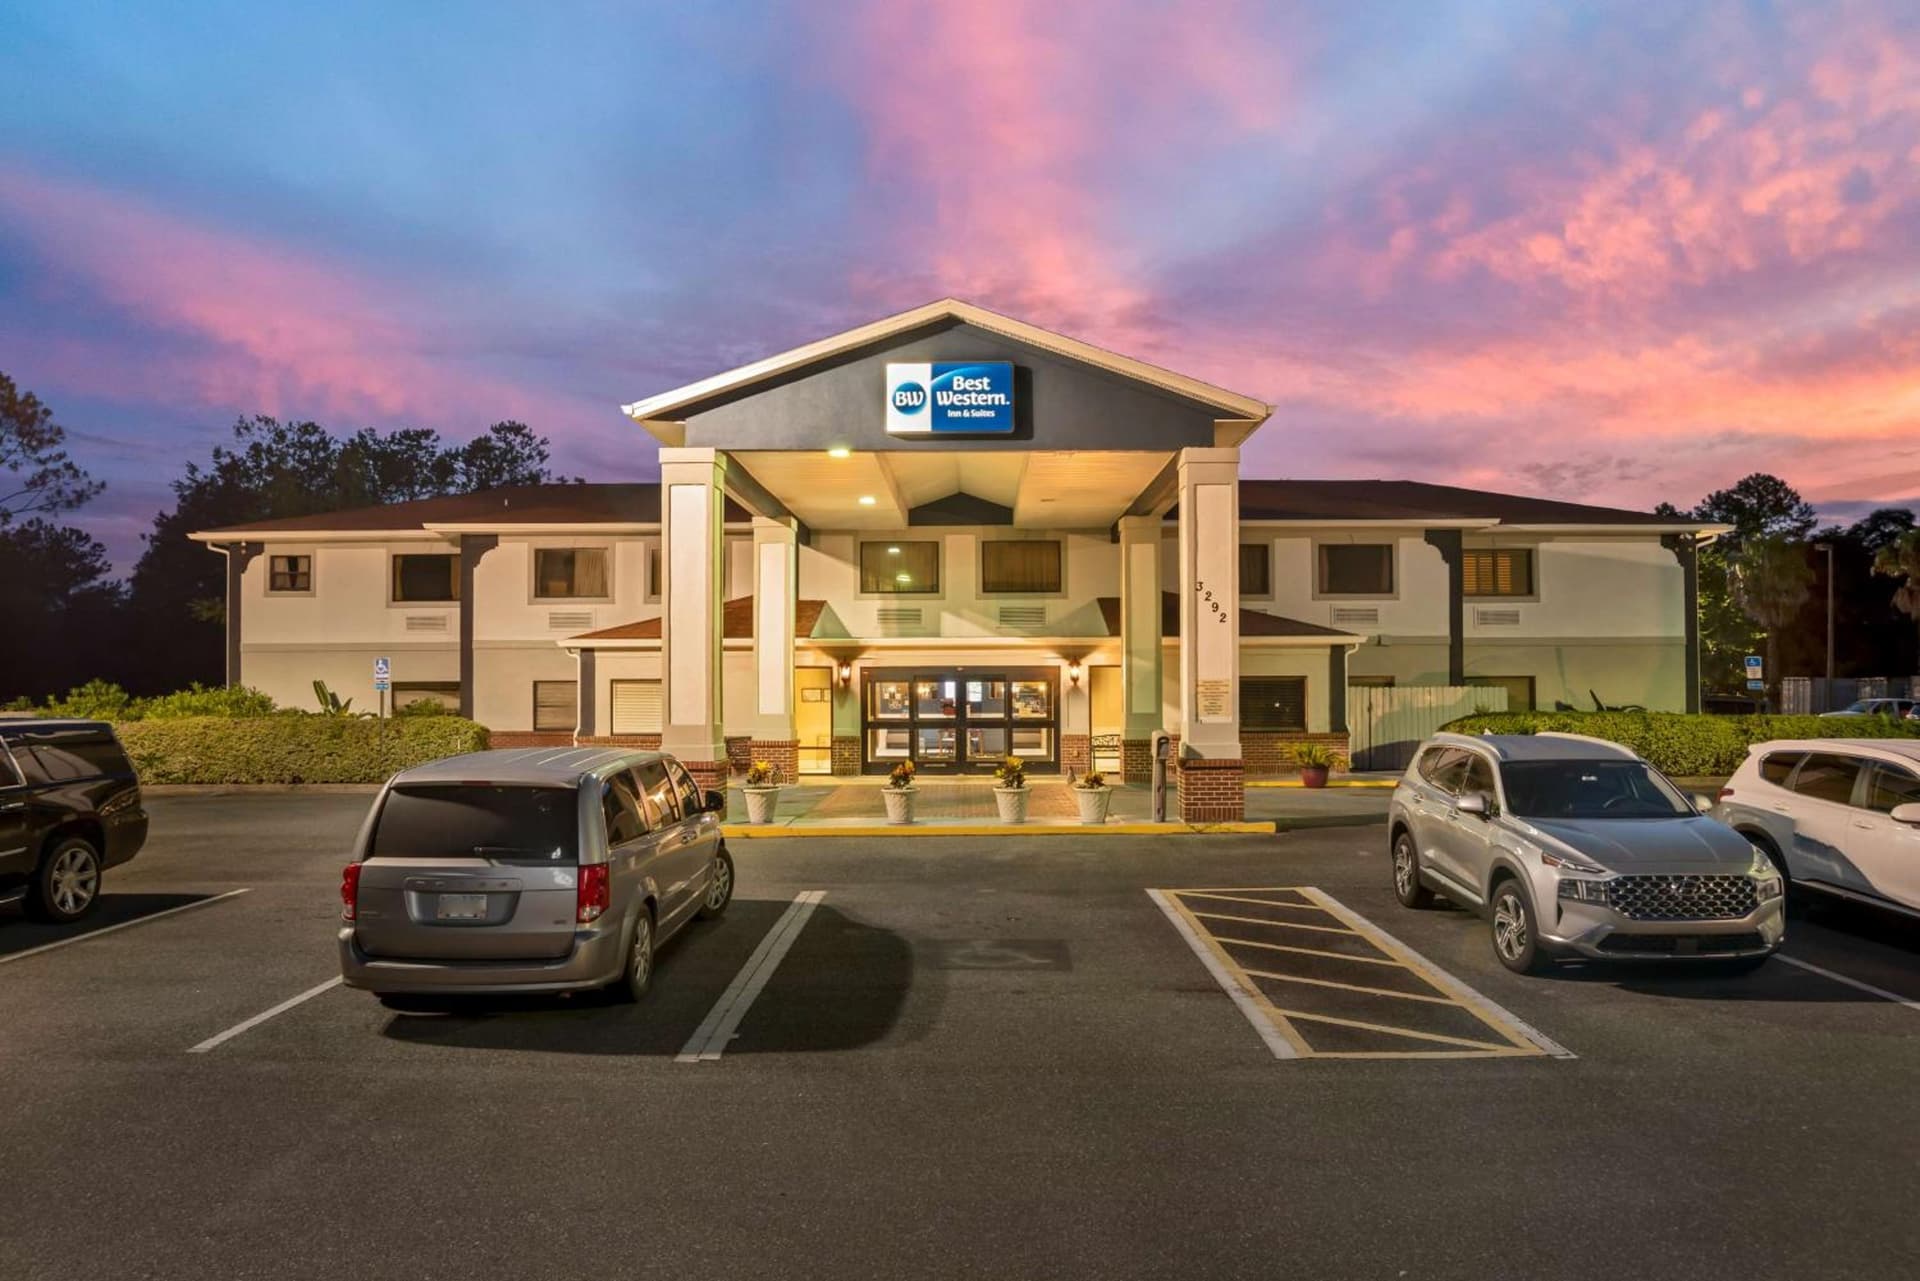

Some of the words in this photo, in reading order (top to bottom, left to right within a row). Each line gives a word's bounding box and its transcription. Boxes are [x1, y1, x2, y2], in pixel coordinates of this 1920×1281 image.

[953, 376, 991, 391] Best
[895, 391, 924, 406] BW
[947, 409, 962, 418] Inn
[963, 409, 970, 418] &
[971, 409, 995, 418] Suites
